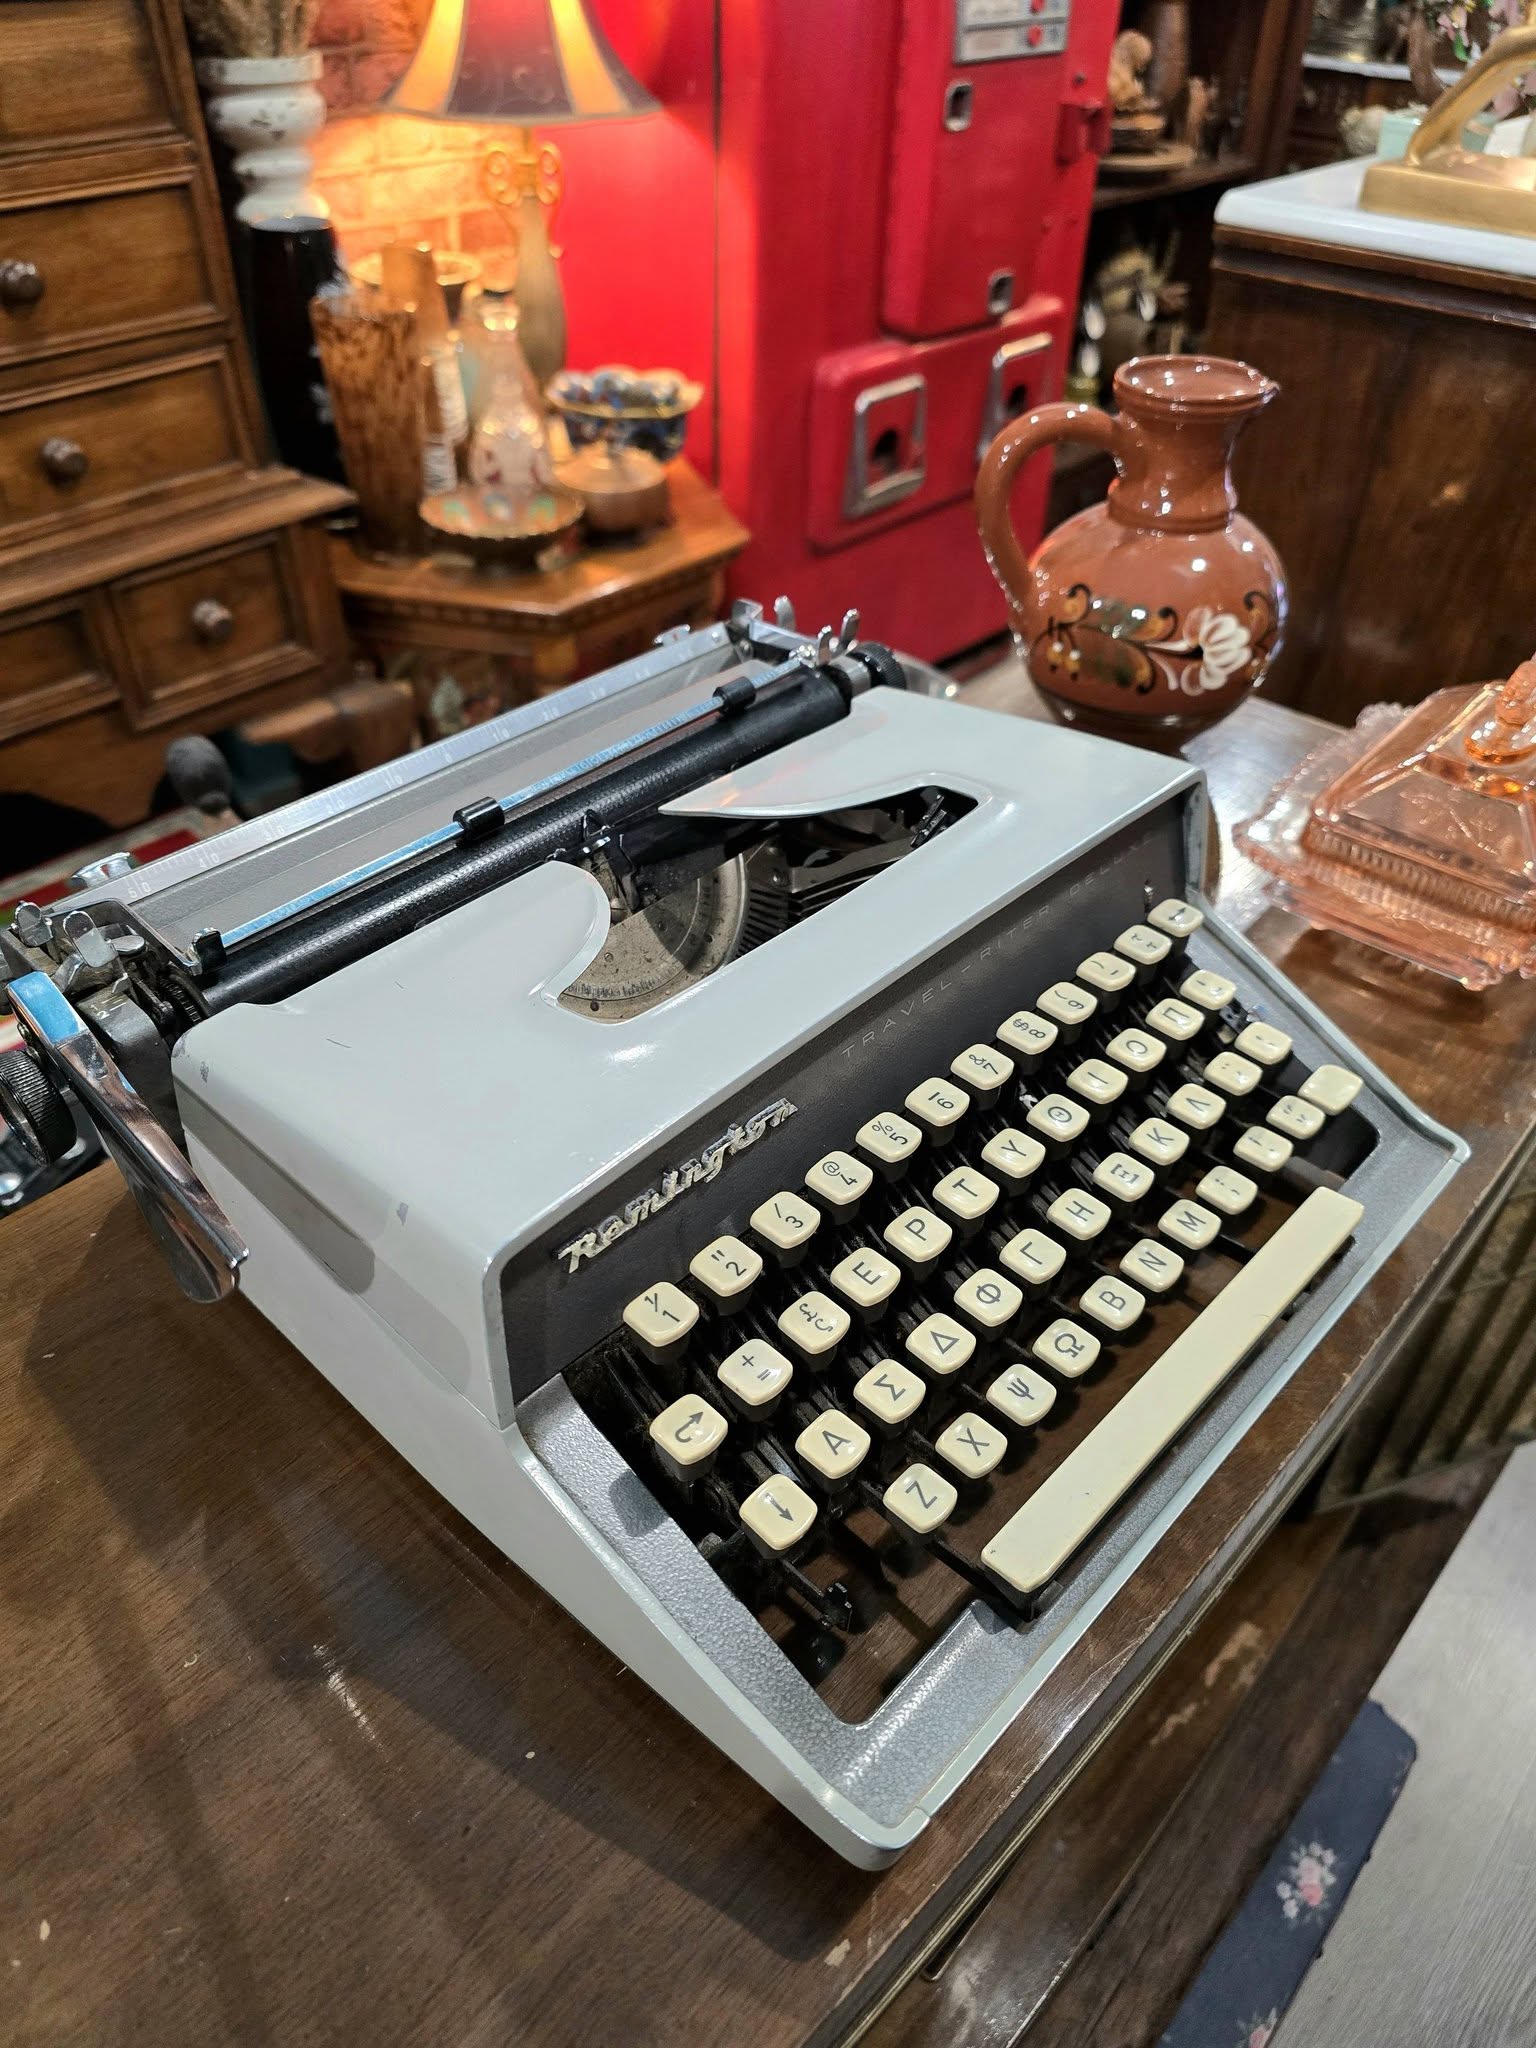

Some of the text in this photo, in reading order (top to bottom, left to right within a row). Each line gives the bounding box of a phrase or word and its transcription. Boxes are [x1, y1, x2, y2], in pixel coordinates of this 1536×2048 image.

[1068, 1000, 1085, 1011] 9
[1028, 1028, 1047, 1040] 8
[981, 1062, 999, 1076] 7
[936, 1097, 955, 1110] 6
[889, 1132, 908, 1146] 5
[557, 1097, 799, 1274] Remington
[840, 1173, 859, 1187] 4
[785, 1215, 804, 1229] 3
[1019, 1241, 1043, 1265] Γ
[725, 1261, 747, 1277] 2
[976, 1283, 1001, 1305] Φ
[930, 1330, 960, 1355] Δ
[1054, 1332, 1085, 1358] Ω
[872, 1373, 906, 1402] Σ
[1007, 1377, 1035, 1401] Ψ
